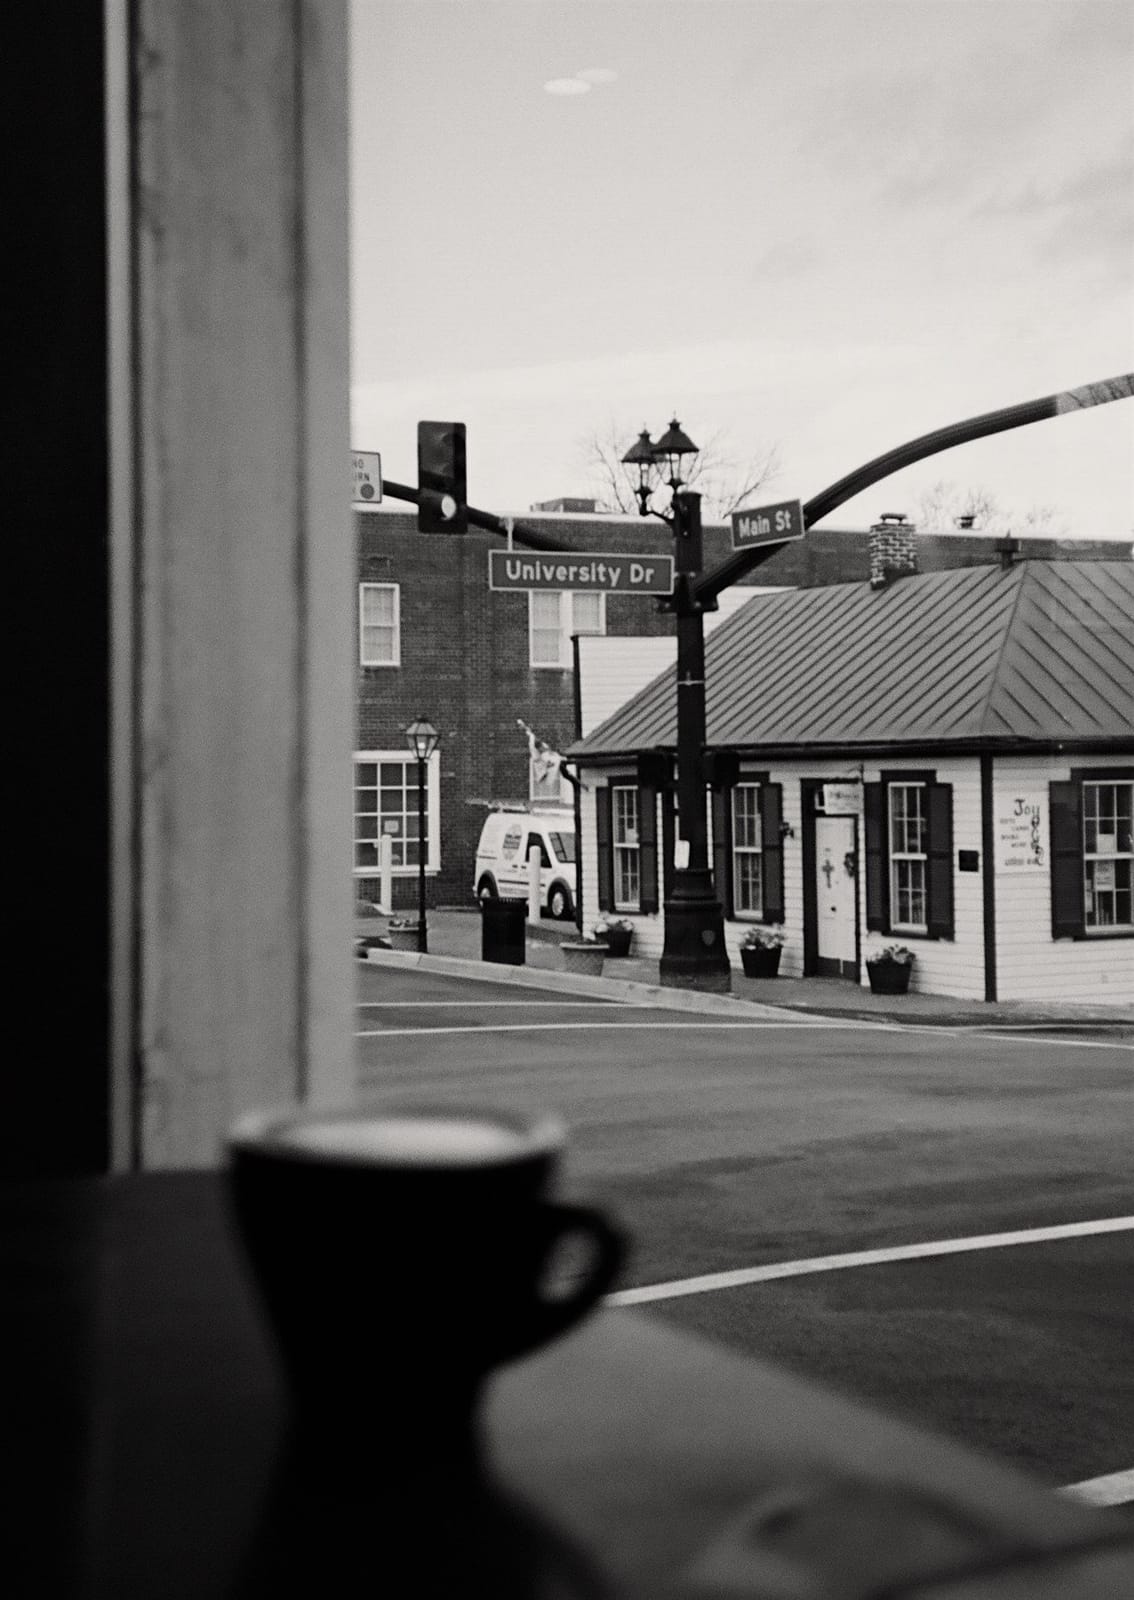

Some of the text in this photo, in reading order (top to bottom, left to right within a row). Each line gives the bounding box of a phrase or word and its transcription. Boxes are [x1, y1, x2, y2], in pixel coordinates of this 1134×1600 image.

[738, 509, 792, 539] Main St
[506, 559, 655, 588] University Dr
